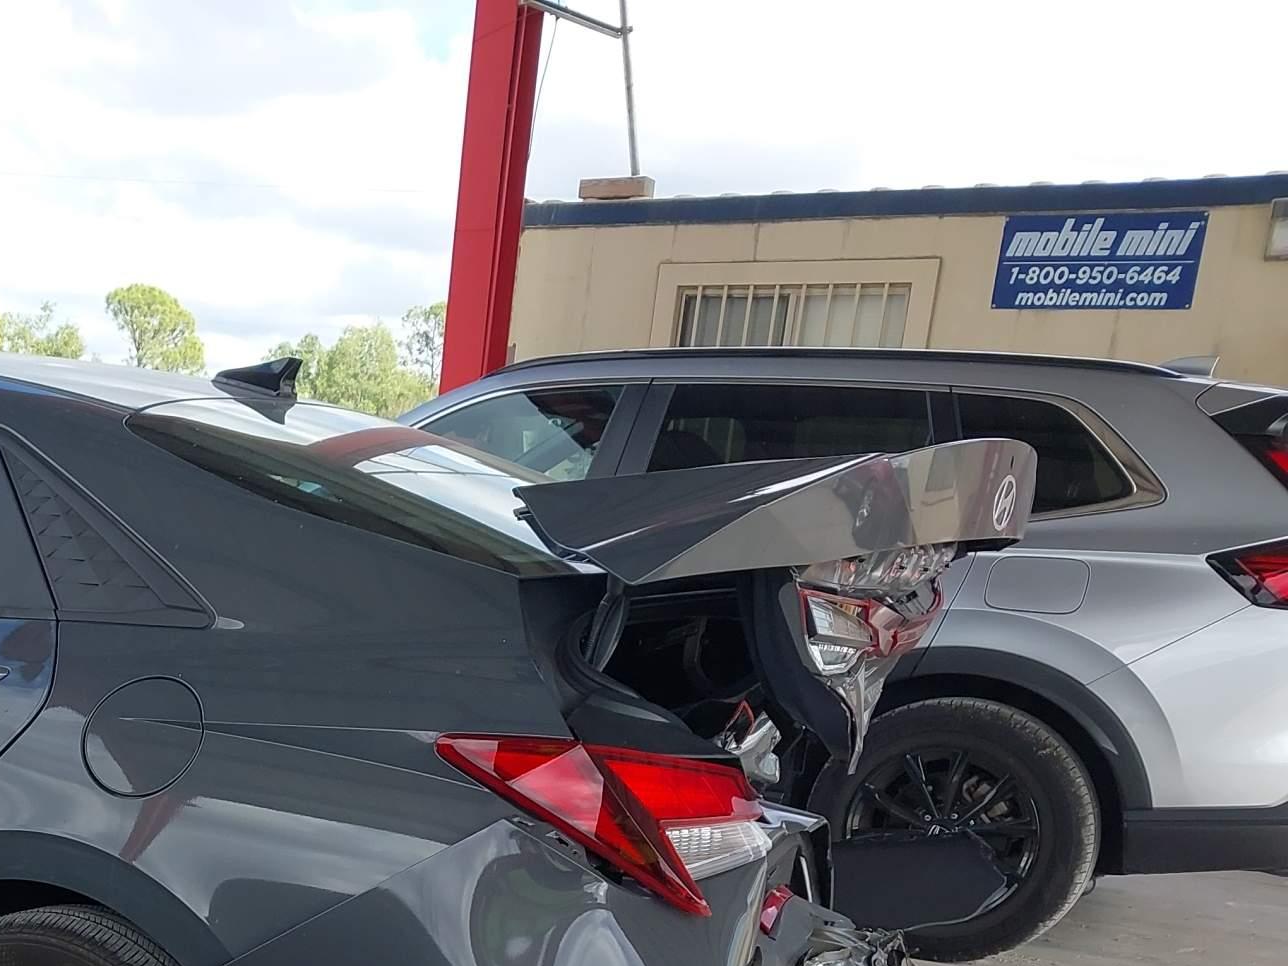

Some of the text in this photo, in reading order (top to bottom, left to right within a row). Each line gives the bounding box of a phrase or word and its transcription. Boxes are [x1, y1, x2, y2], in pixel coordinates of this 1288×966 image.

[1005, 217, 1201, 257] mobile mini
[1009, 265, 1183, 285] 1-800-950-6464
[1014, 288, 1168, 306] mobilemini.com
